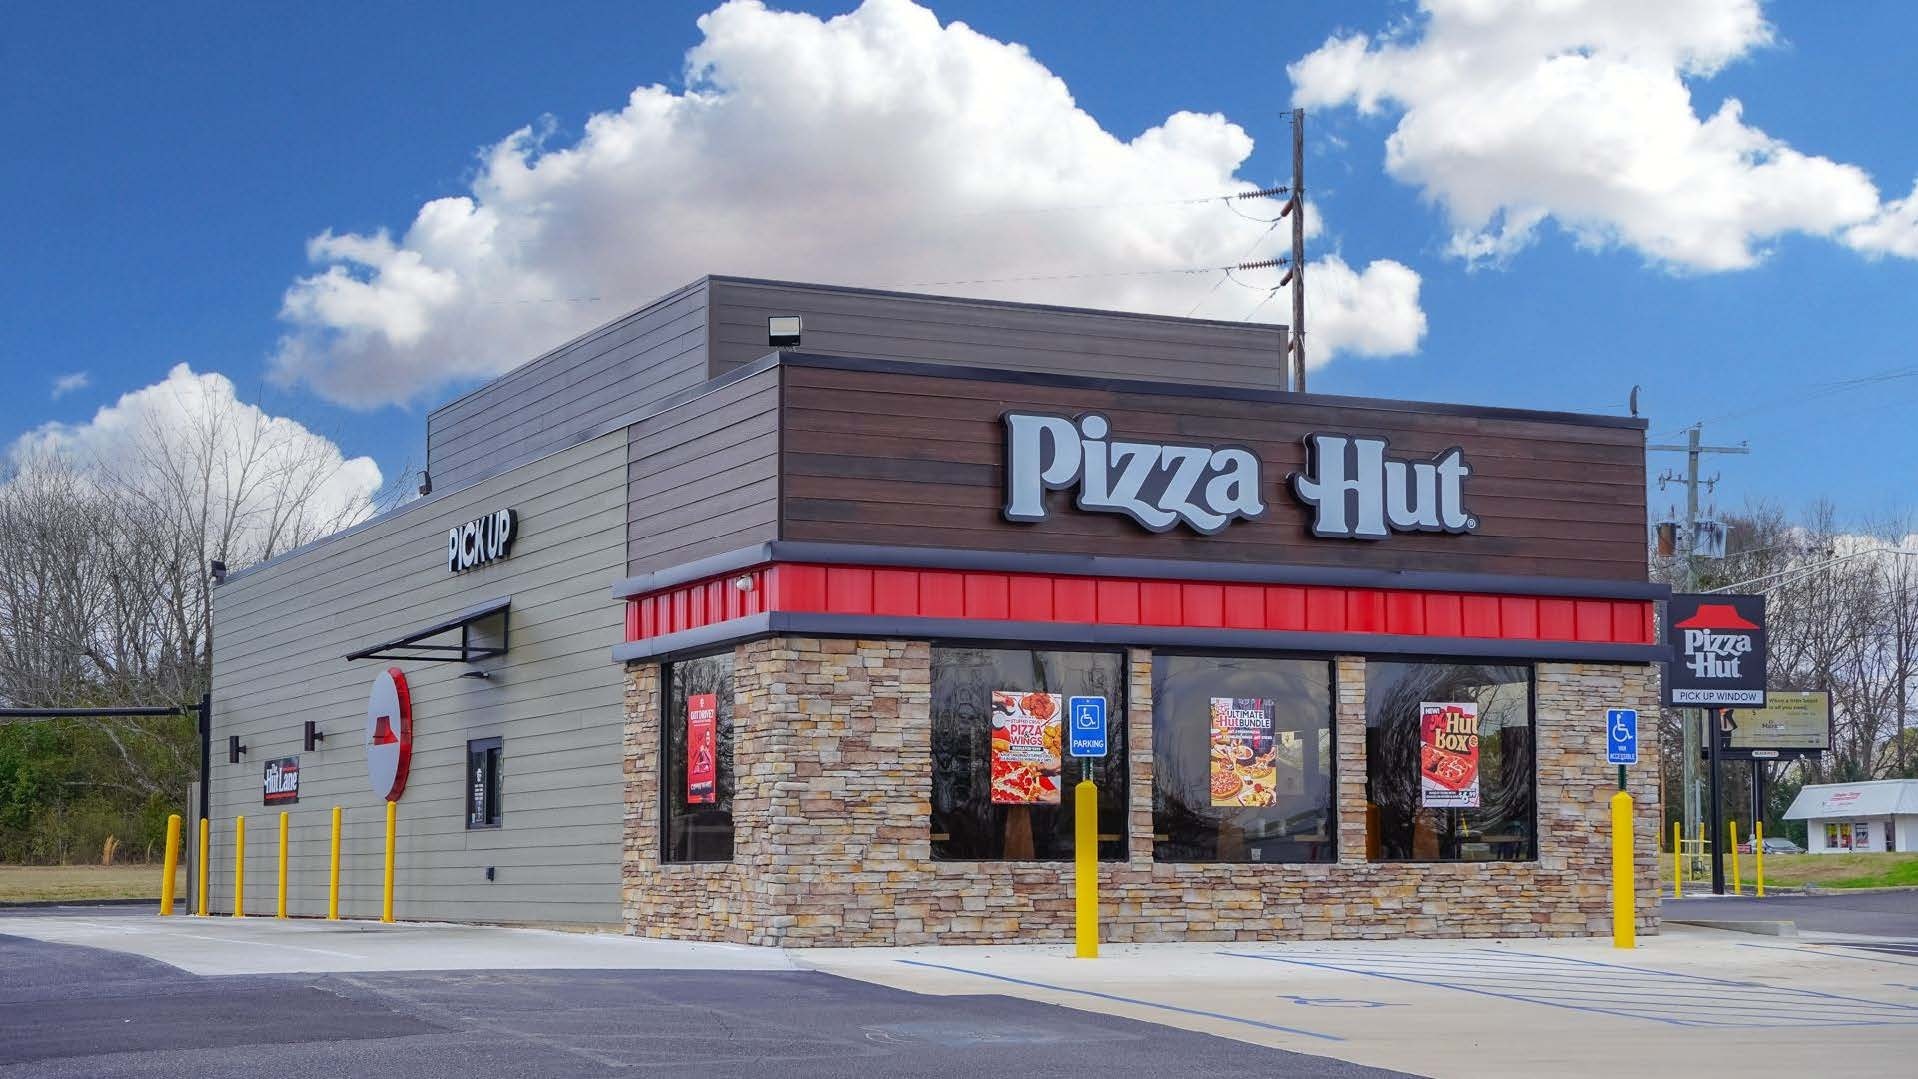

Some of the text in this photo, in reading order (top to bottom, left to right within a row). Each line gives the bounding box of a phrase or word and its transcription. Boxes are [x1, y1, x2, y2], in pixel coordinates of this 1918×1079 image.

[1009, 414, 1469, 536] Pizza Hut
[449, 509, 510, 572] PICK UP
[1684, 629, 1752, 656] Pizza
[1686, 652, 1741, 678] Hut
[1680, 691, 1757, 701] PICK UP WINDOW
[1216, 715, 1270, 727] Hut BUNDLE
[1227, 710, 1264, 719] ULTIMATE
[1011, 724, 1042, 736] PIZZA
[1446, 712, 1478, 735] Hut
[1011, 736, 1043, 745] WINGS
[1074, 740, 1104, 748] PARKING
[264, 768, 297, 793] Hut Lane
